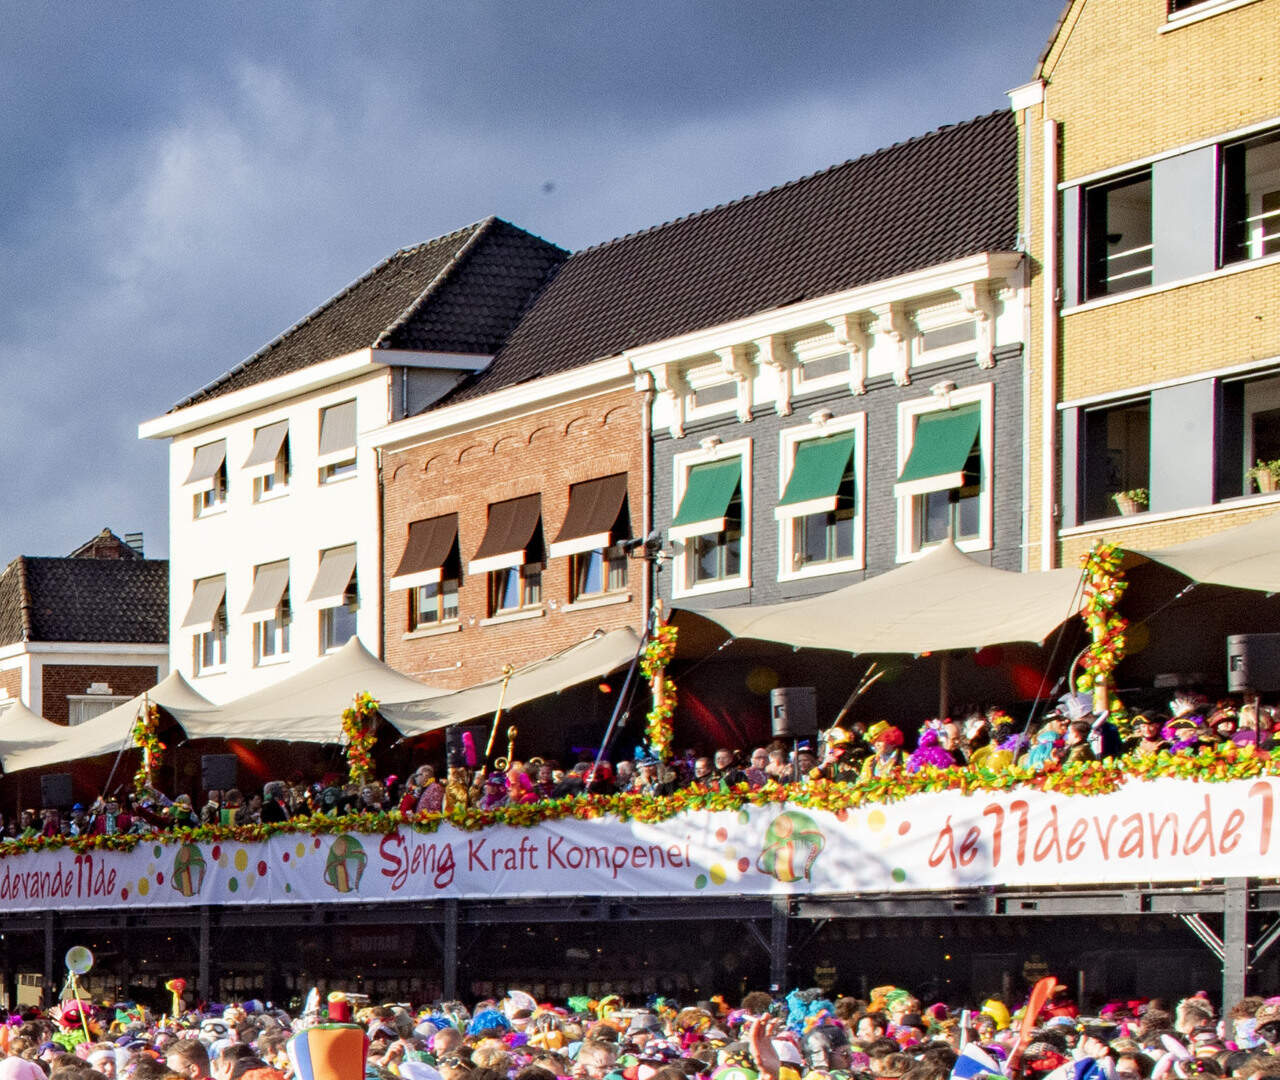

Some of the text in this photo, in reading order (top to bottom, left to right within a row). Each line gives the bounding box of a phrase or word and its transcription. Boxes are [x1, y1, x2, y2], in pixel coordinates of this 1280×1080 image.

[379, 832, 692, 891] Sjeng Kraft Kompenei
